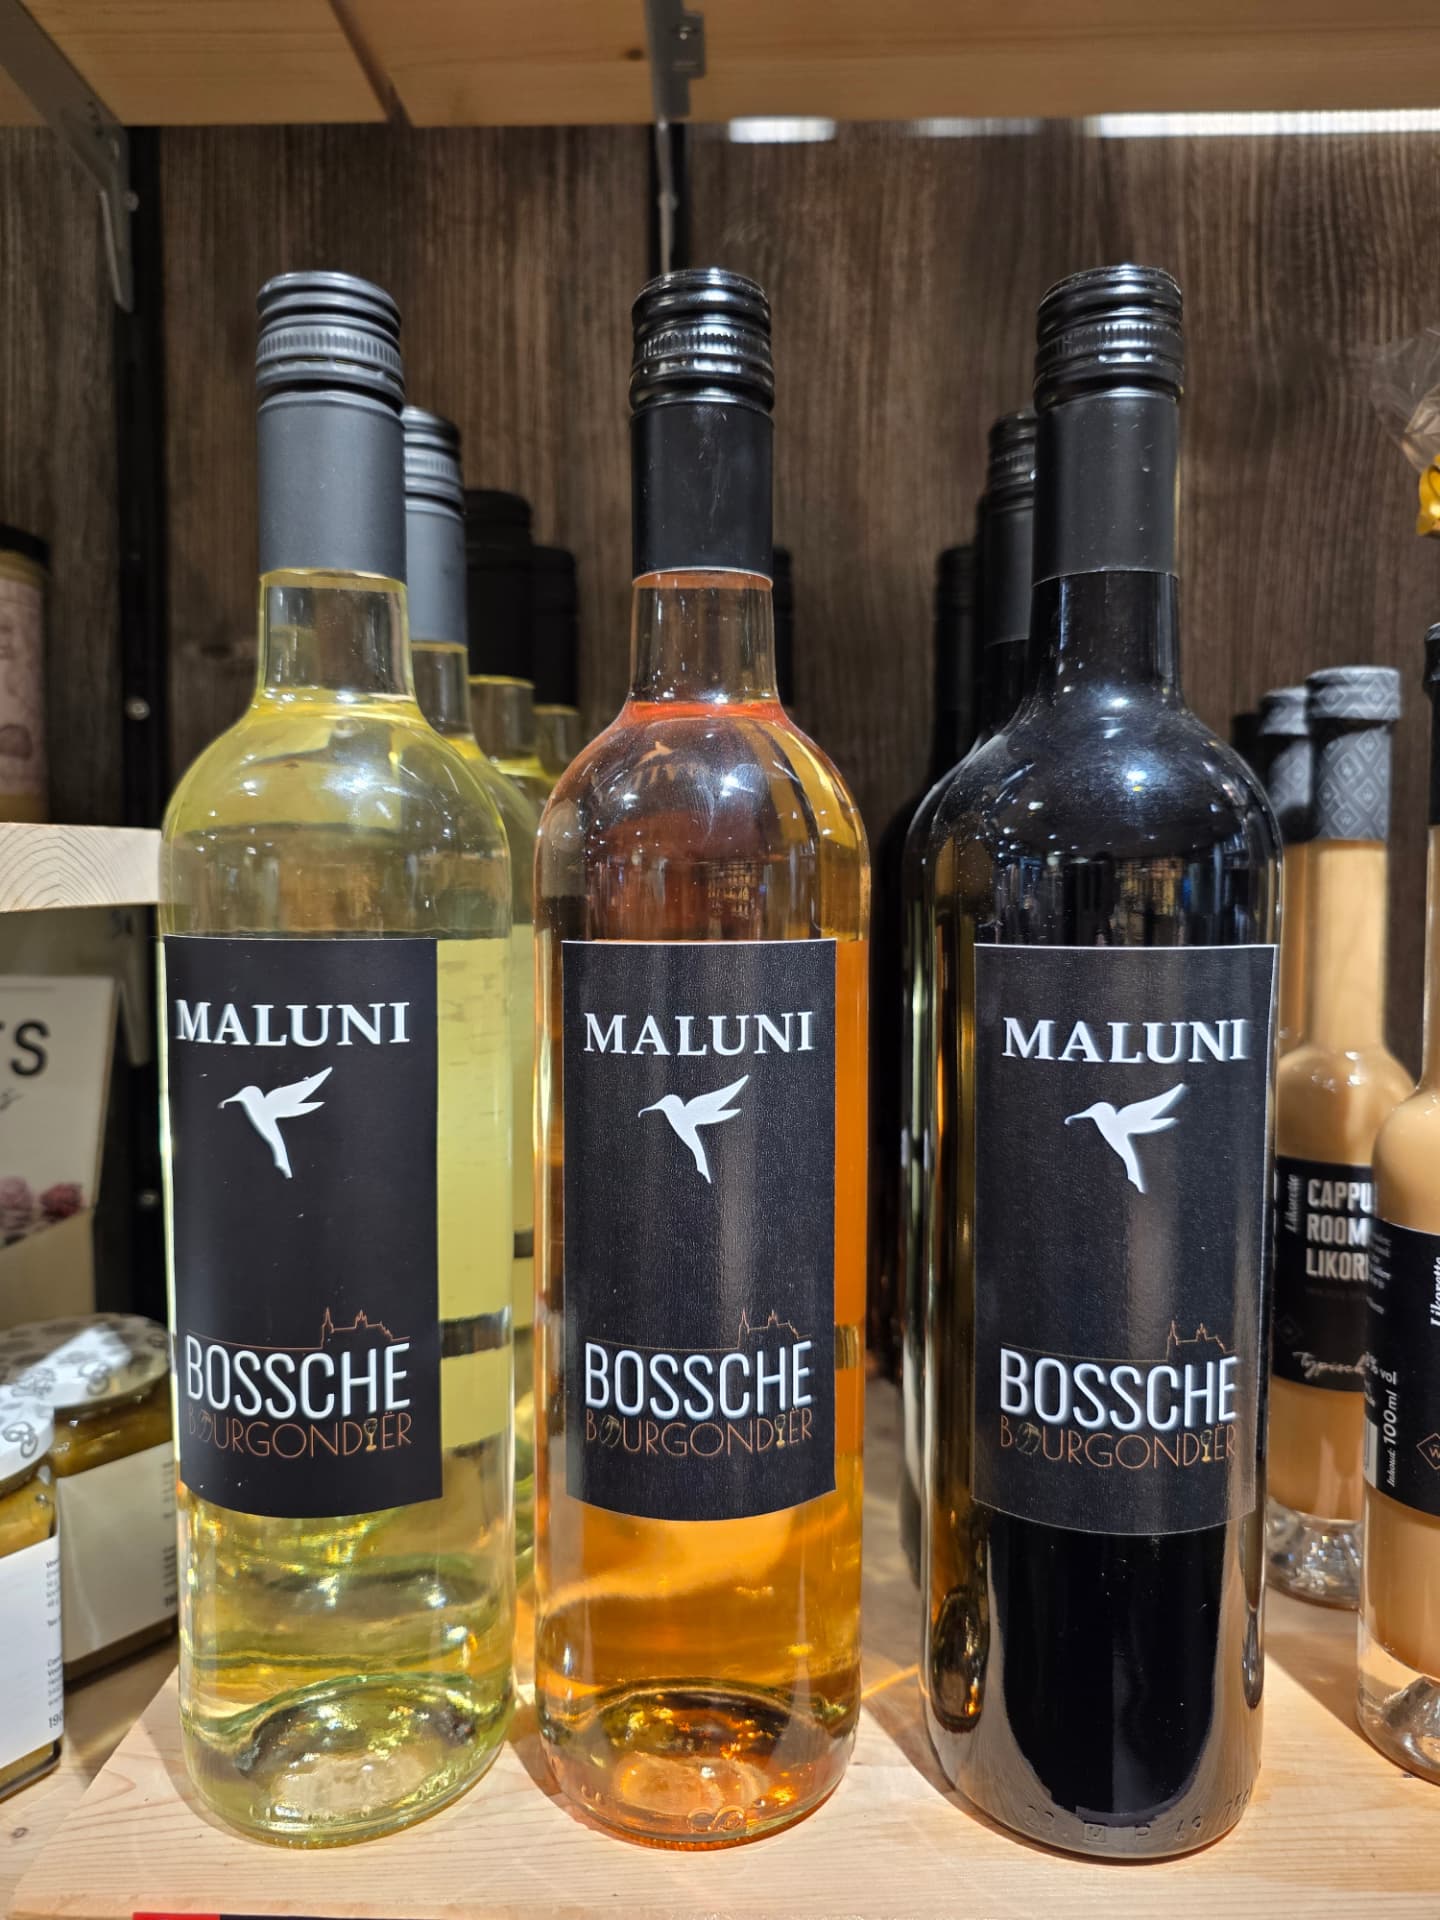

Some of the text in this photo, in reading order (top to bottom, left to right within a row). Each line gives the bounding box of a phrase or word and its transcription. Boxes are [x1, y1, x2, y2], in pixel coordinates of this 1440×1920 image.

[0, 1020, 50, 1077] S
[175, 999, 411, 1047] MALUNI
[583, 1011, 815, 1057] MALUNI
[1002, 1017, 1248, 1064] MALUNI
[1307, 1214, 1370, 1247] ROOM
[185, 1335, 411, 1420] BOSSCHE
[585, 1341, 814, 1421] BOSSCHE
[1000, 1348, 1240, 1432] BOSSCHE
[1383, 1388, 1398, 1445] 100ml
